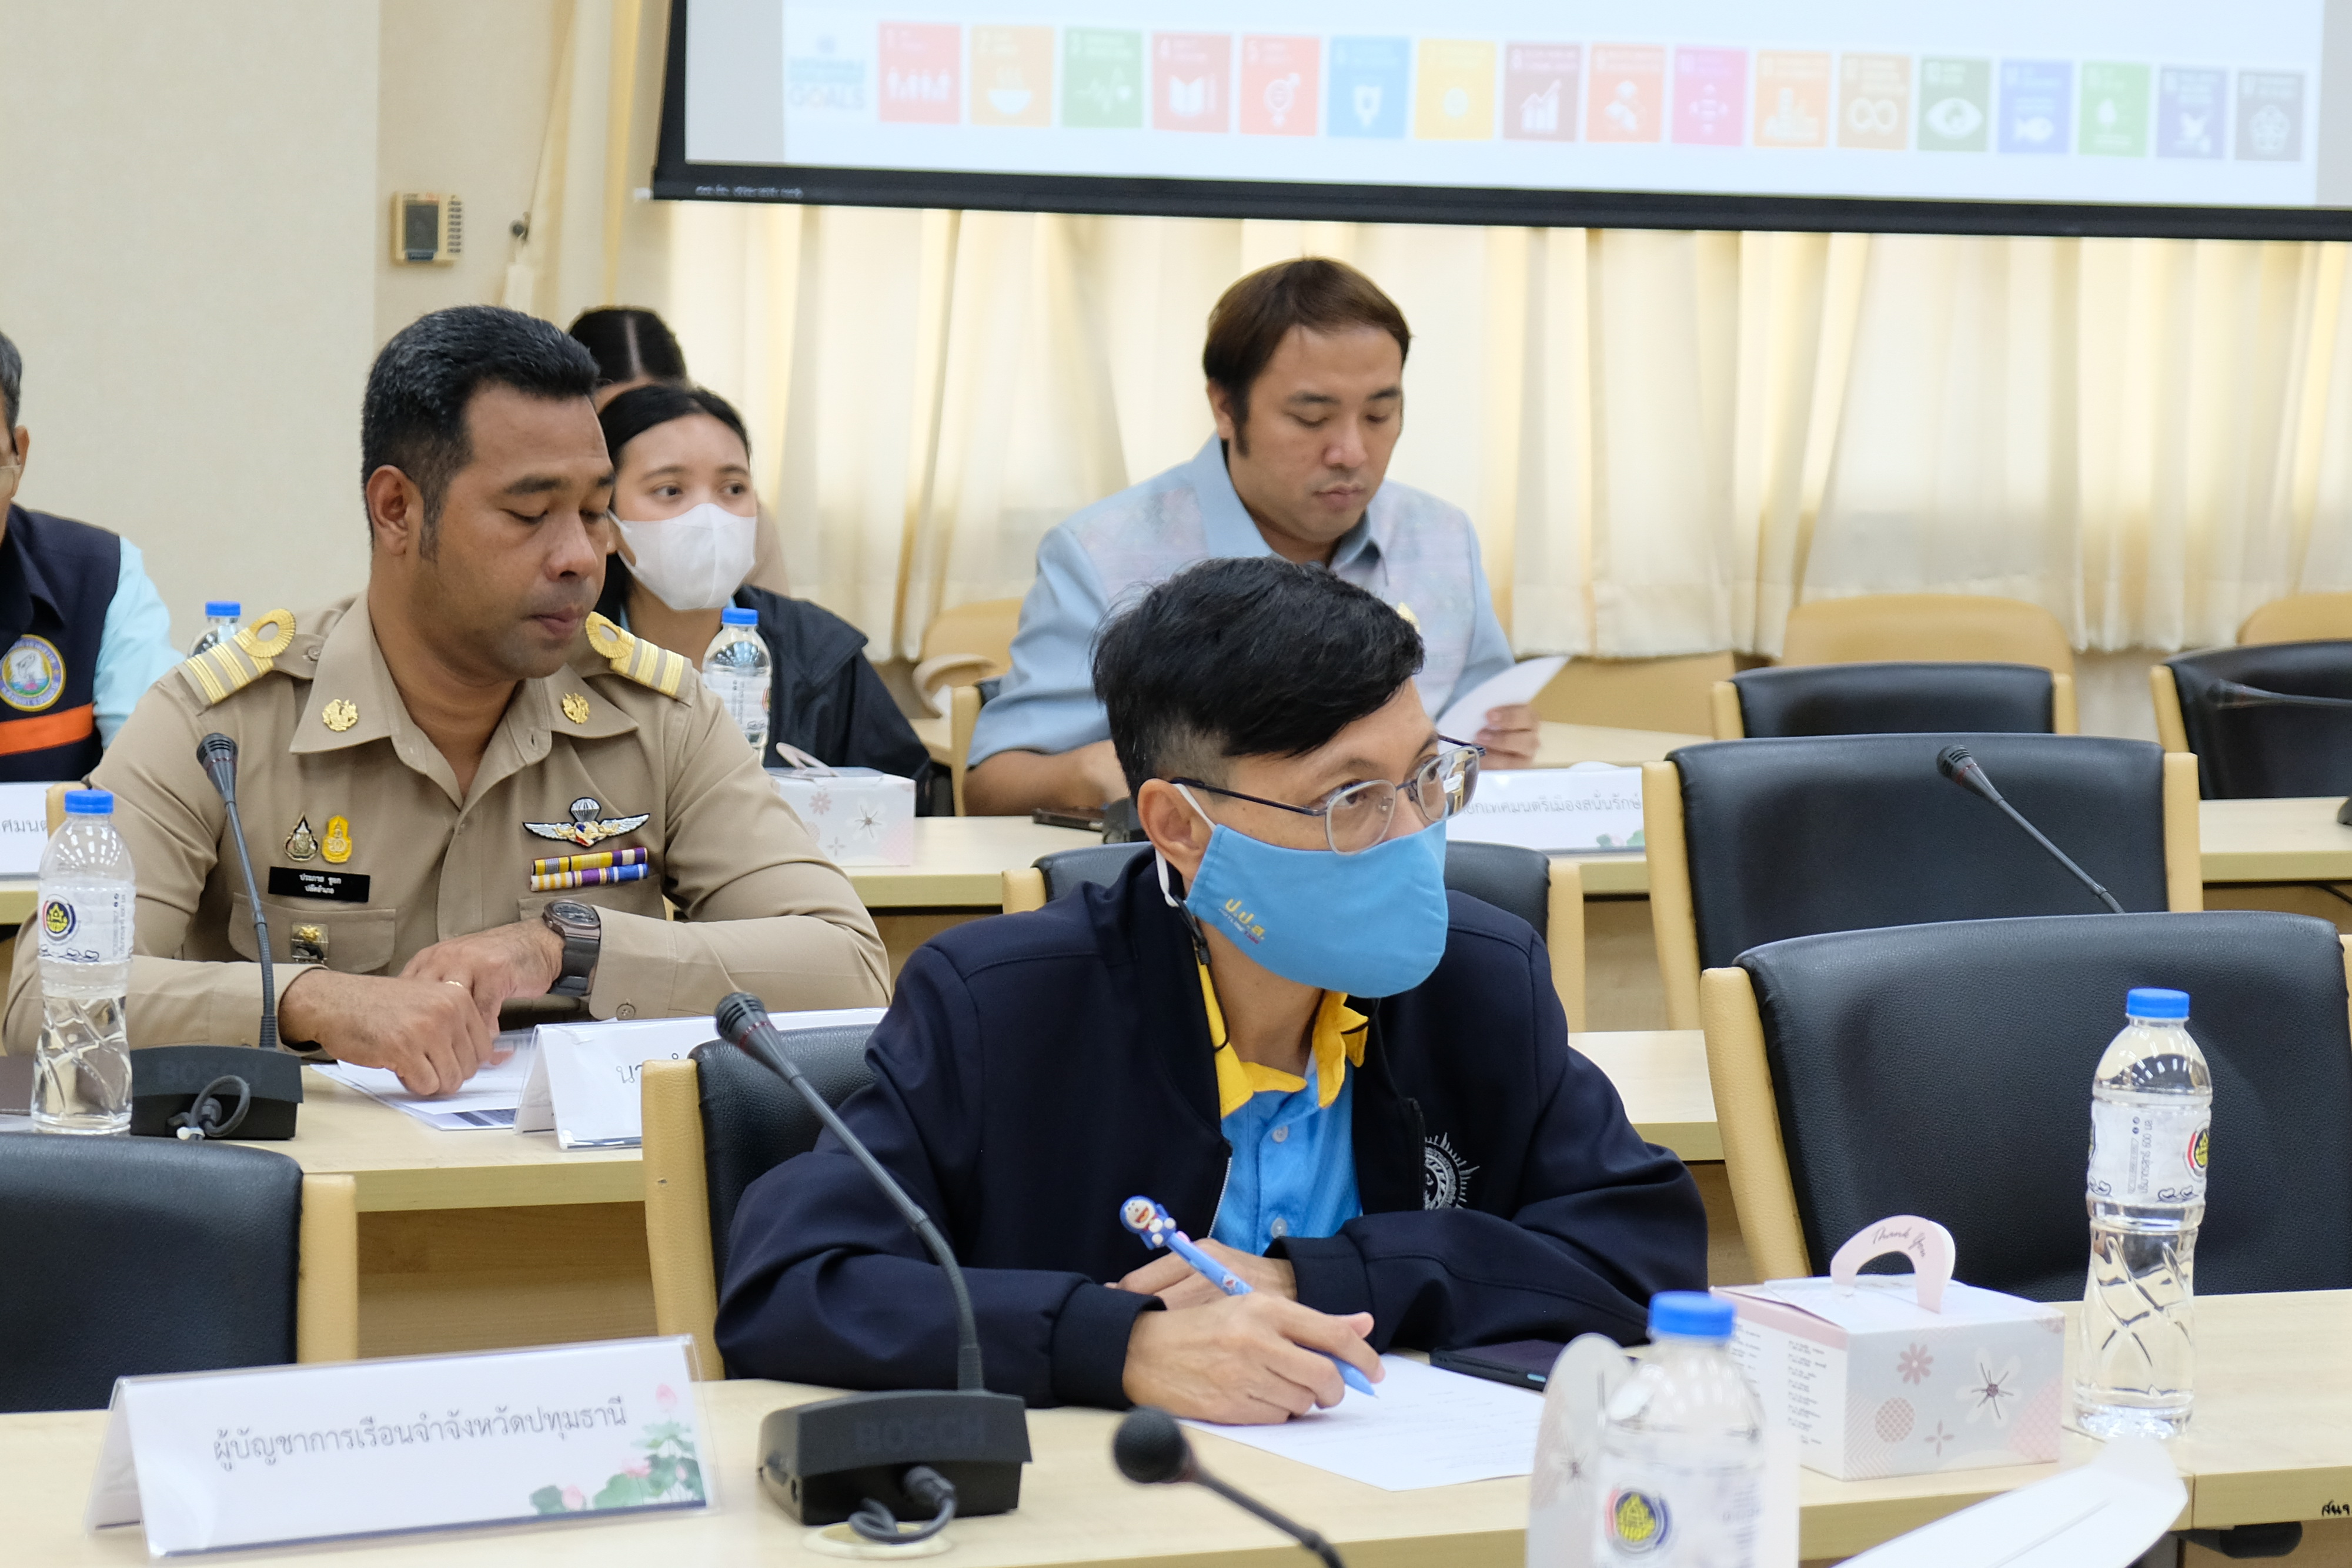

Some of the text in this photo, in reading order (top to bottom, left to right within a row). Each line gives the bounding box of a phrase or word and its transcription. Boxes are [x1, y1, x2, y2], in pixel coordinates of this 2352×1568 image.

[213, 1395, 627, 1471] ผู้บัญชาการเรือนจำจังหวัดปทุมธานี
